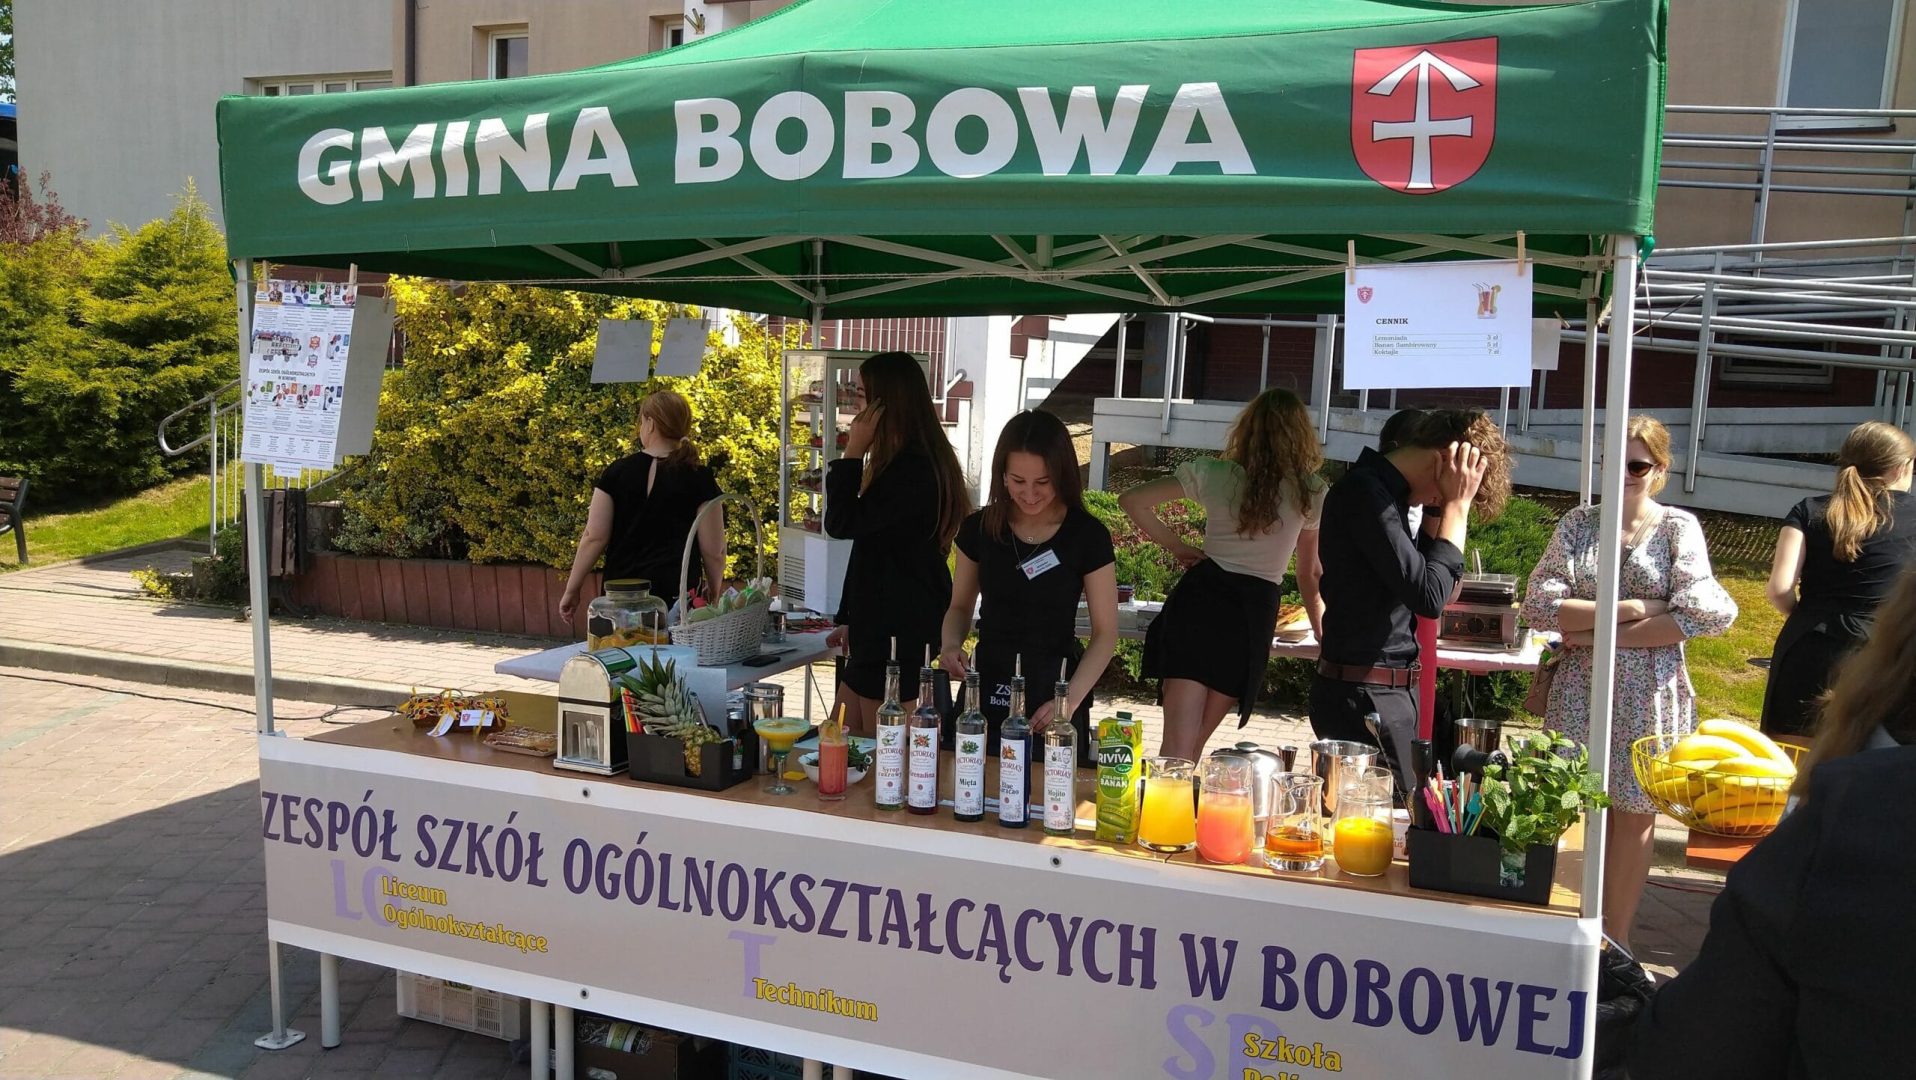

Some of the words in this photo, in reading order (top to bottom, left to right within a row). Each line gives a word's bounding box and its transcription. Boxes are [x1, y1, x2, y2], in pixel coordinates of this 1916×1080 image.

[297, 106, 639, 206] GMINA
[674, 81, 1257, 185] BOBOWA
[1375, 317, 1409, 325] CENNIK
[995, 683, 1011, 696] ZS
[990, 695, 1011, 707] Bobo
[1098, 753, 1132, 763] RIVIVA
[882, 766, 900, 774] Syrop
[959, 778, 977, 788] Mięta
[1047, 789, 1066, 798] Mojito
[1100, 779, 1128, 788] BANAN
[382, 876, 448, 906] Liceum
[262, 789, 402, 862] ZESPÓŁ
[414, 811, 549, 888] SZKÓŁ
[562, 831, 1157, 990] OGÓLNOKSZTAŁCĄCYCH
[1179, 933, 1238, 1001] W
[1260, 945, 1588, 1060] BOBOWEJ
[383, 903, 549, 953] Ogólnokształcące
[727, 930, 778, 999] T
[752, 977, 878, 1022] Technikum
[1161, 1003, 1286, 1080] SP
[1242, 1032, 1343, 1072] Szkoła
